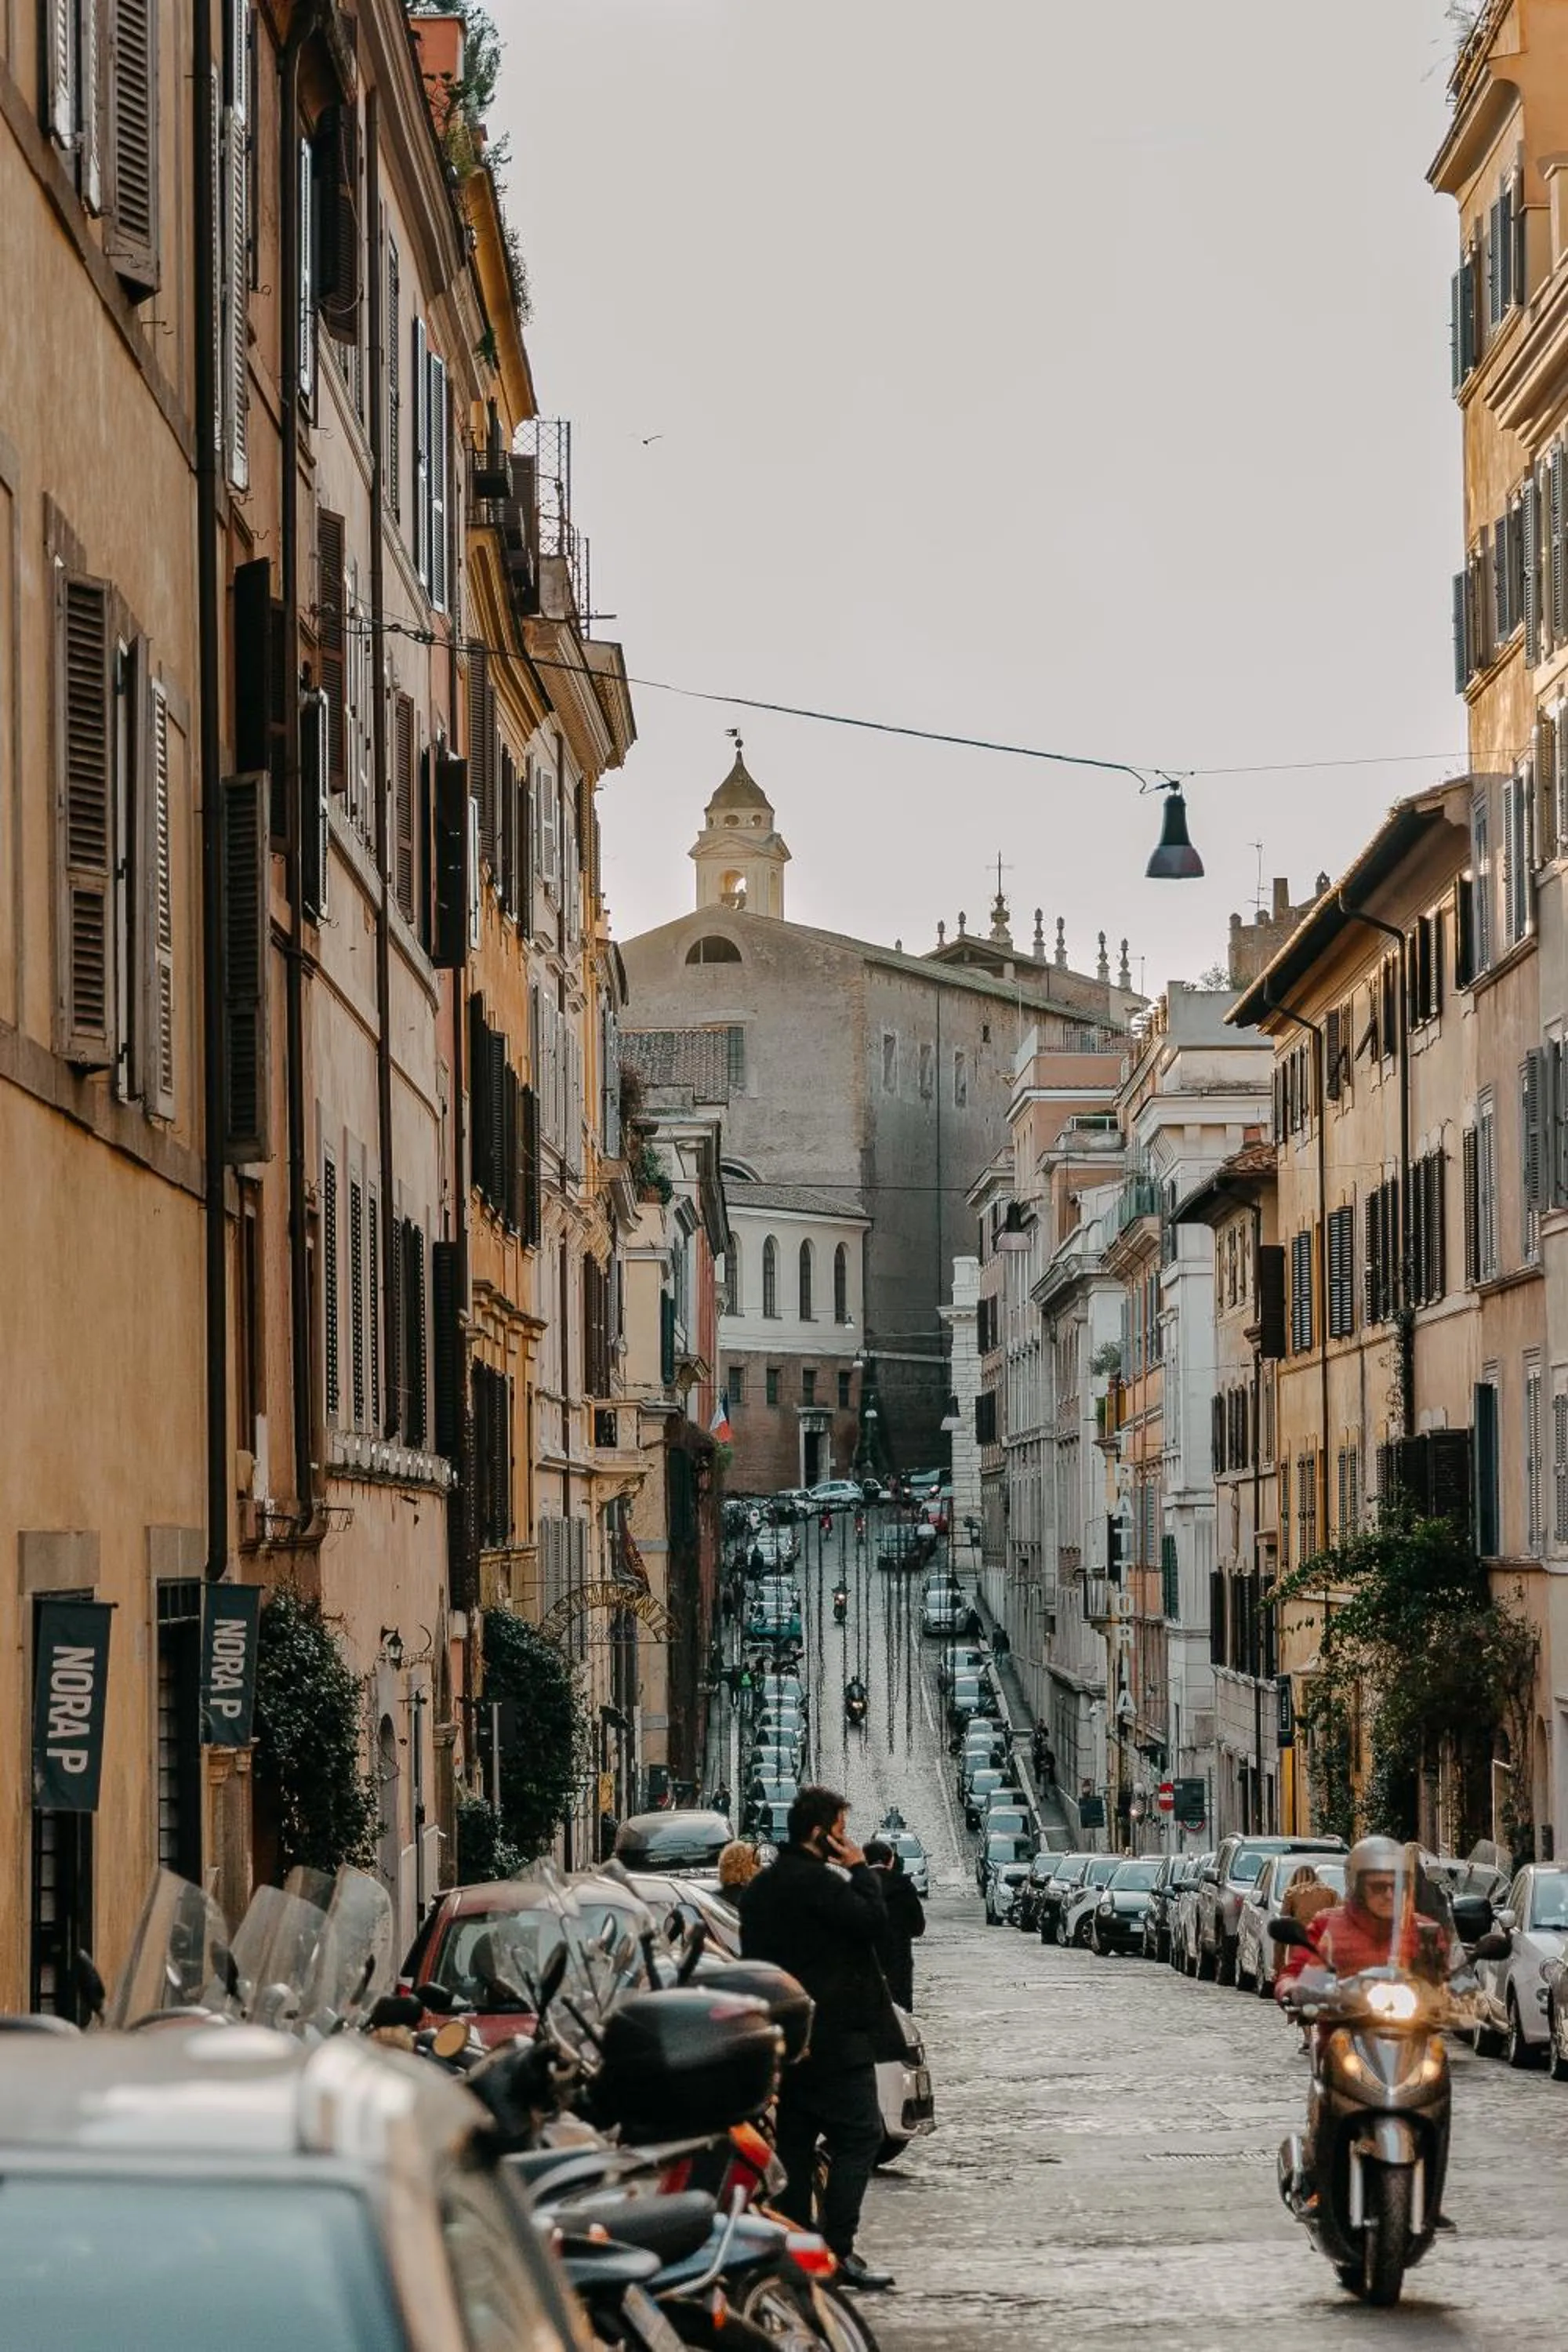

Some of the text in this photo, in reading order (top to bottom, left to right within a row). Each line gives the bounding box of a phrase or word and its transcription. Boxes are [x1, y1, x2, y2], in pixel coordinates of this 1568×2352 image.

[1114, 1431, 1138, 1715] TRATTORIA
[46, 1646, 95, 1774] NORA P
[210, 1618, 247, 1719] NORA P
